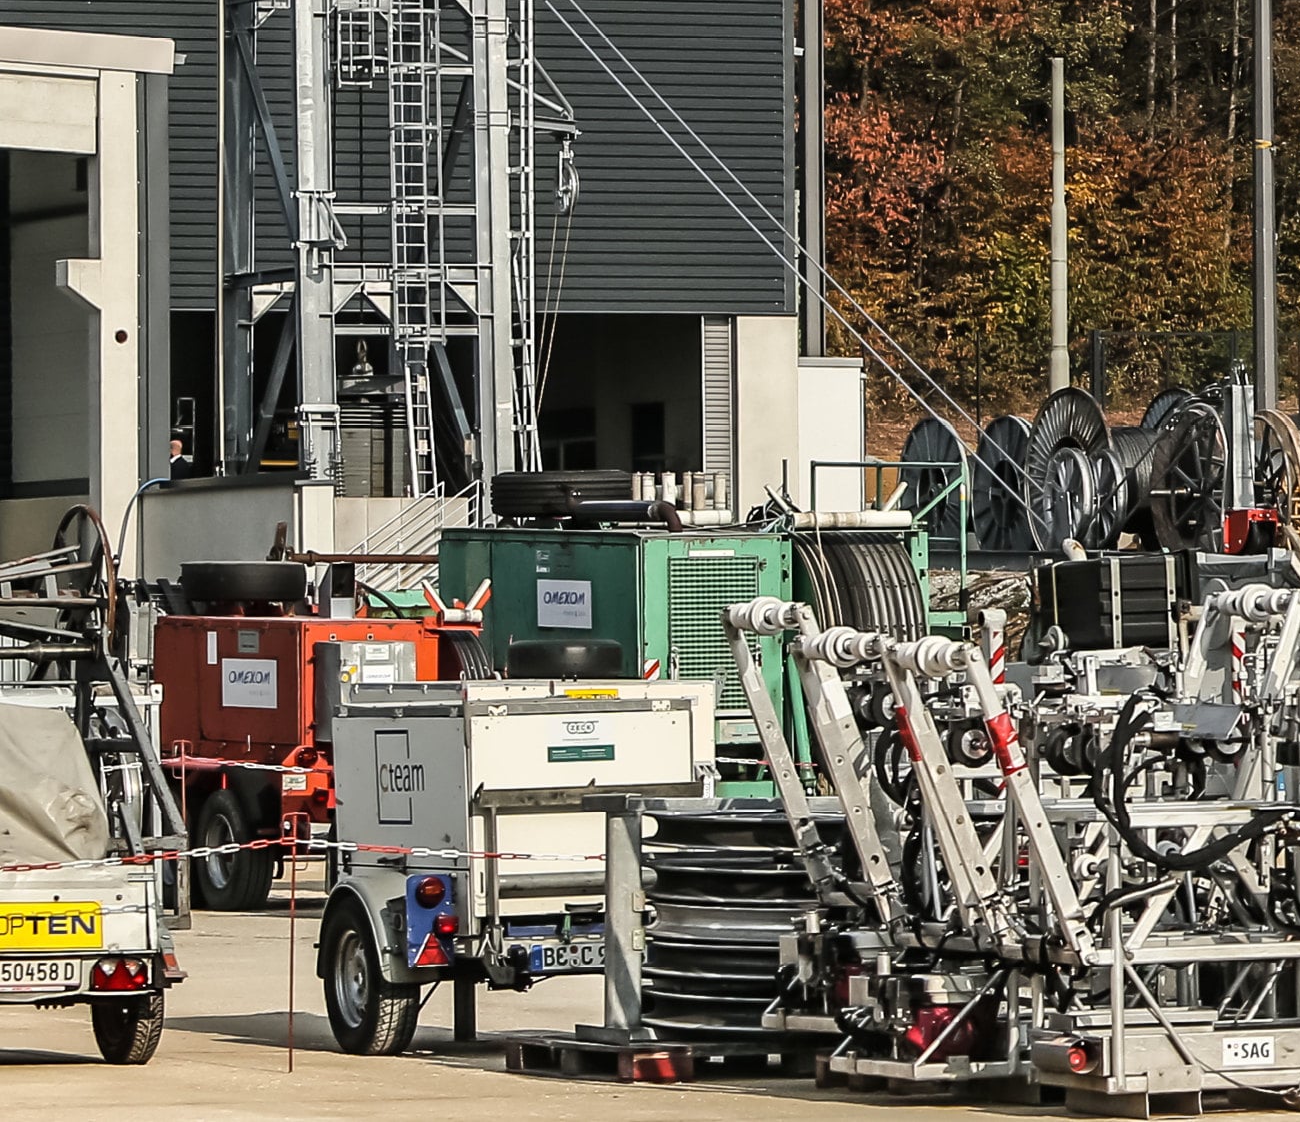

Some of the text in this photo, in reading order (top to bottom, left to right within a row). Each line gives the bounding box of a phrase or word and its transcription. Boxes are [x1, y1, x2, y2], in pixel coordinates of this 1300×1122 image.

[581, 946, 594, 966] C
[2, 962, 59, 982] 50458
[1241, 1042, 1270, 1059] SAG
